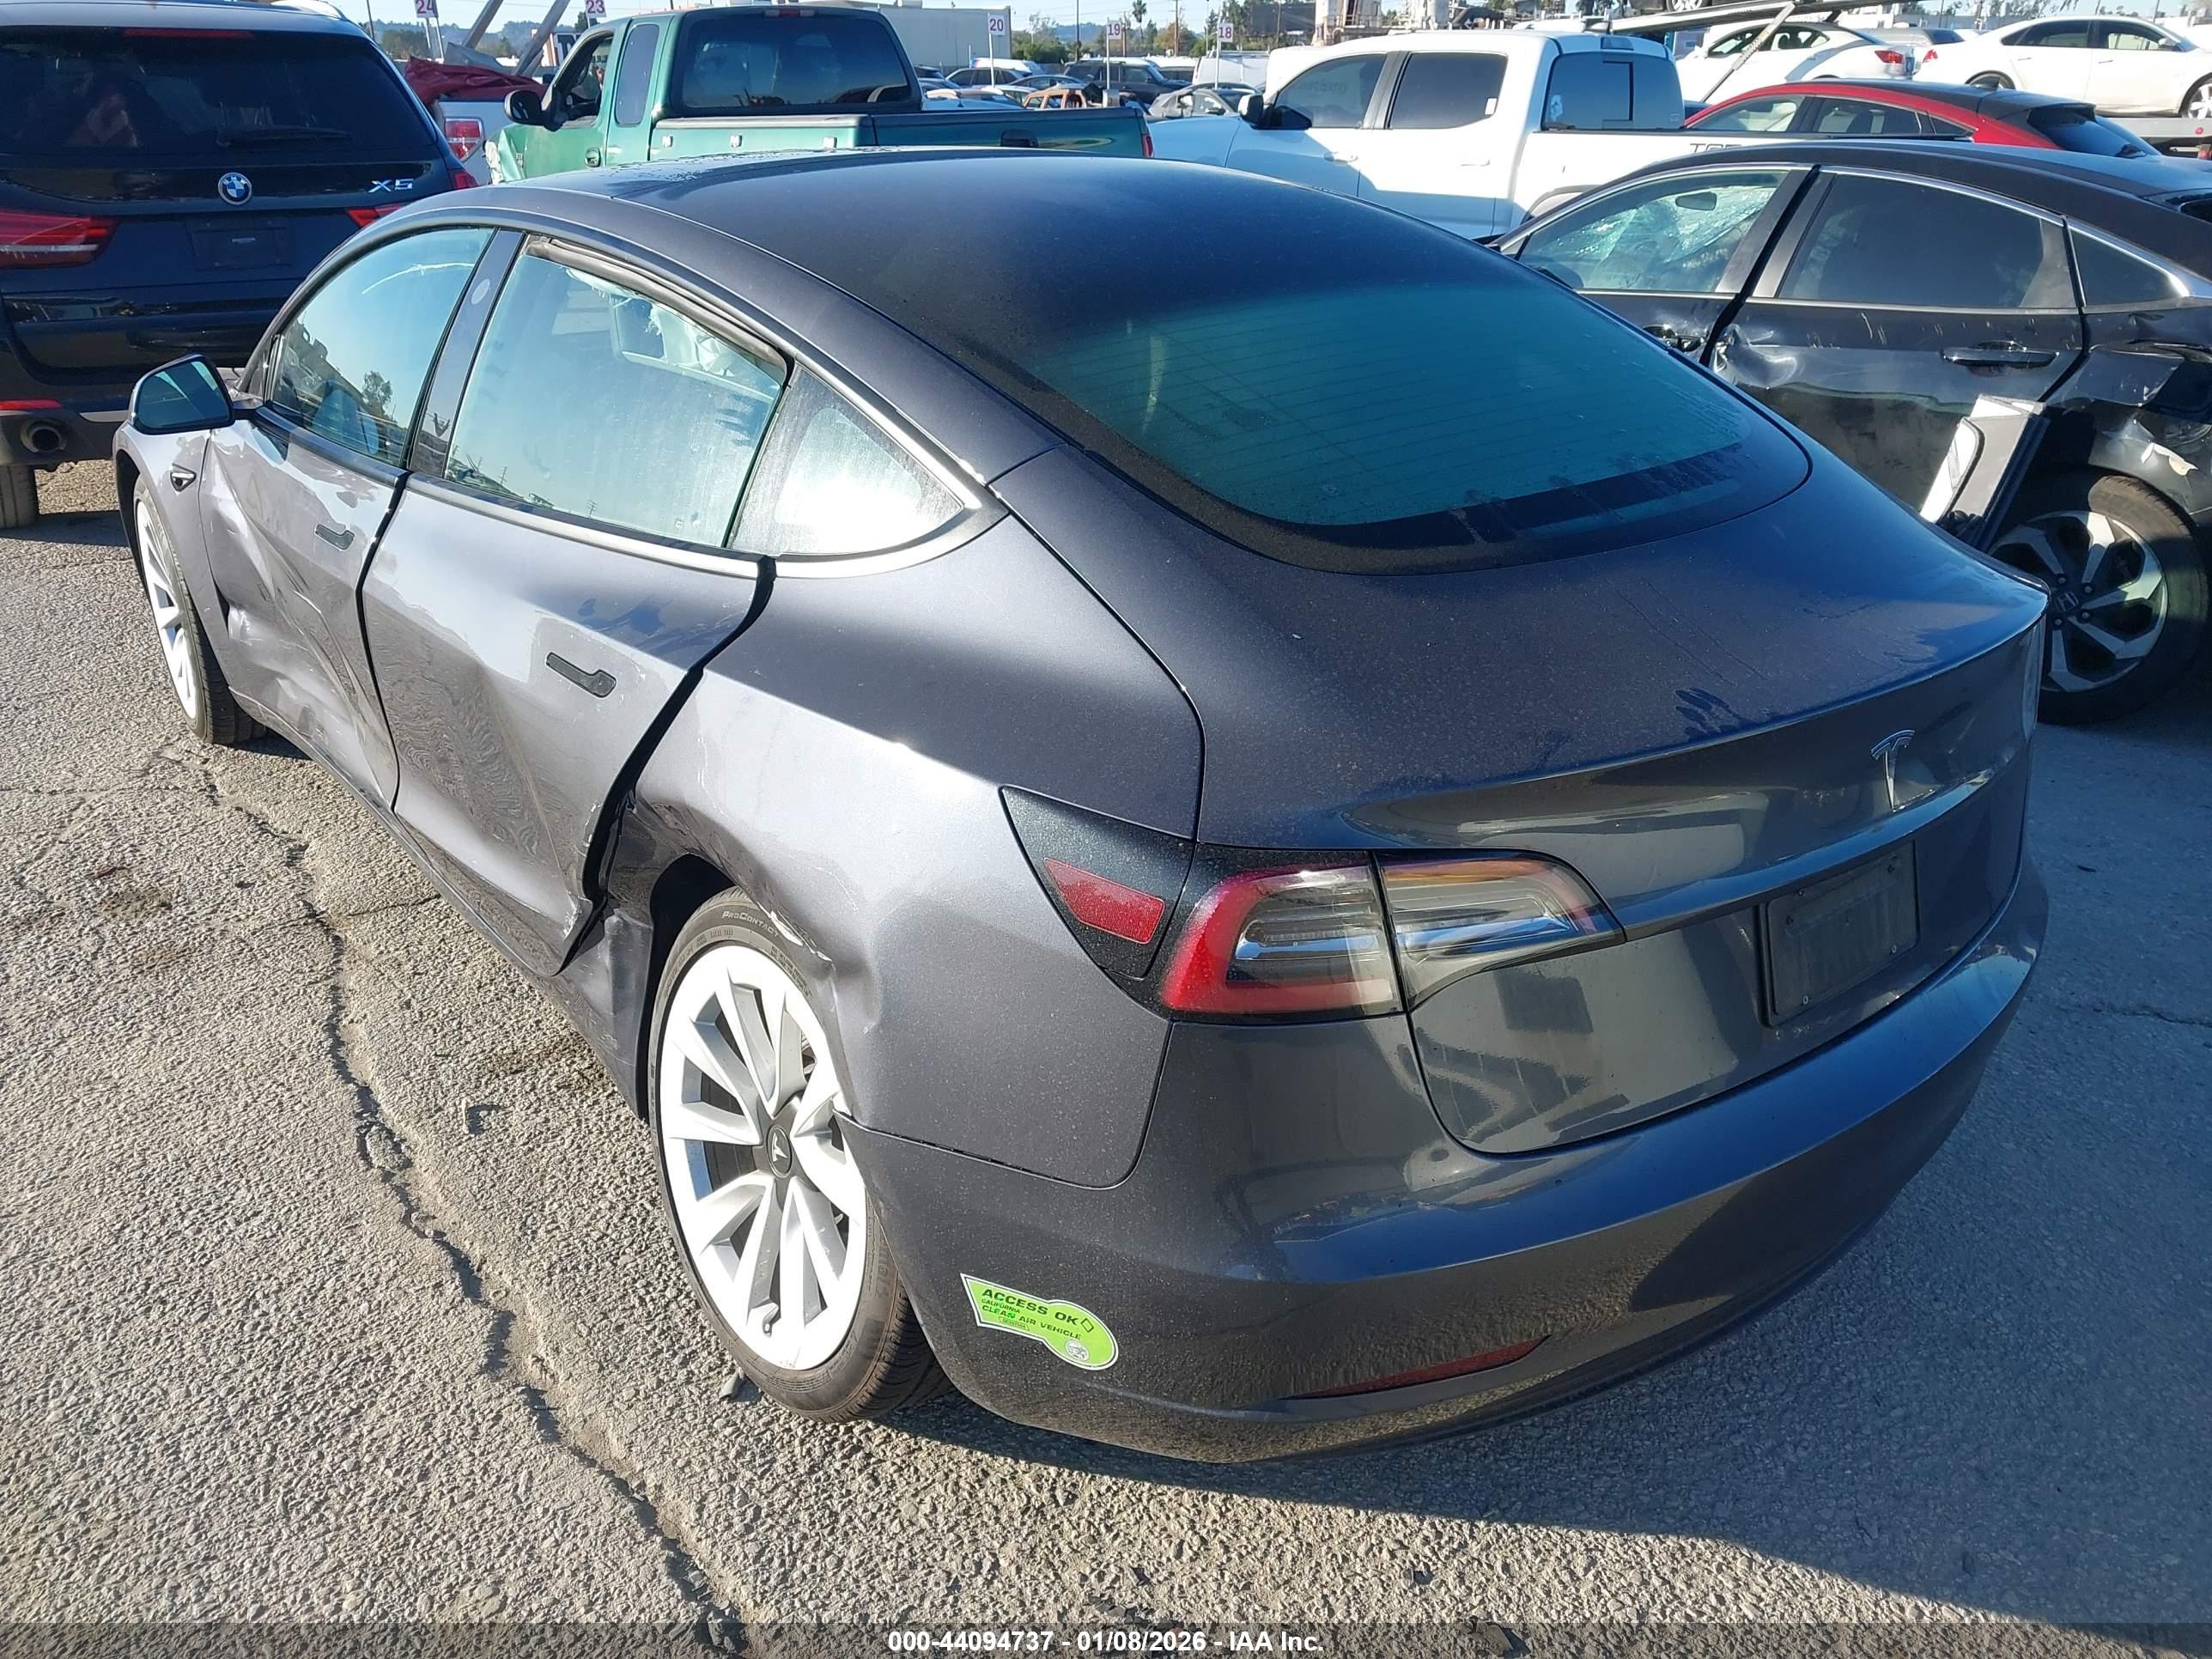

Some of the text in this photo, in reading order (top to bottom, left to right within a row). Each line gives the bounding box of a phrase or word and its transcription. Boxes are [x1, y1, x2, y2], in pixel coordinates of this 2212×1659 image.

[416, 0, 433, 14] 24
[586, 0, 605, 14] 23
[989, 18, 1004, 32] 20
[1108, 23, 1121, 36] 19
[1218, 27, 1232, 39] 18
[368, 178, 414, 193] X5
[981, 1298, 1020, 1314] CALIFORNIA
[982, 1289, 1079, 1325] ACCESS OK
[982, 1304, 1016, 1319] CLEAN
[1018, 1316, 1036, 1326] AIR
[1040, 1322, 1081, 1340] VEHICLE
